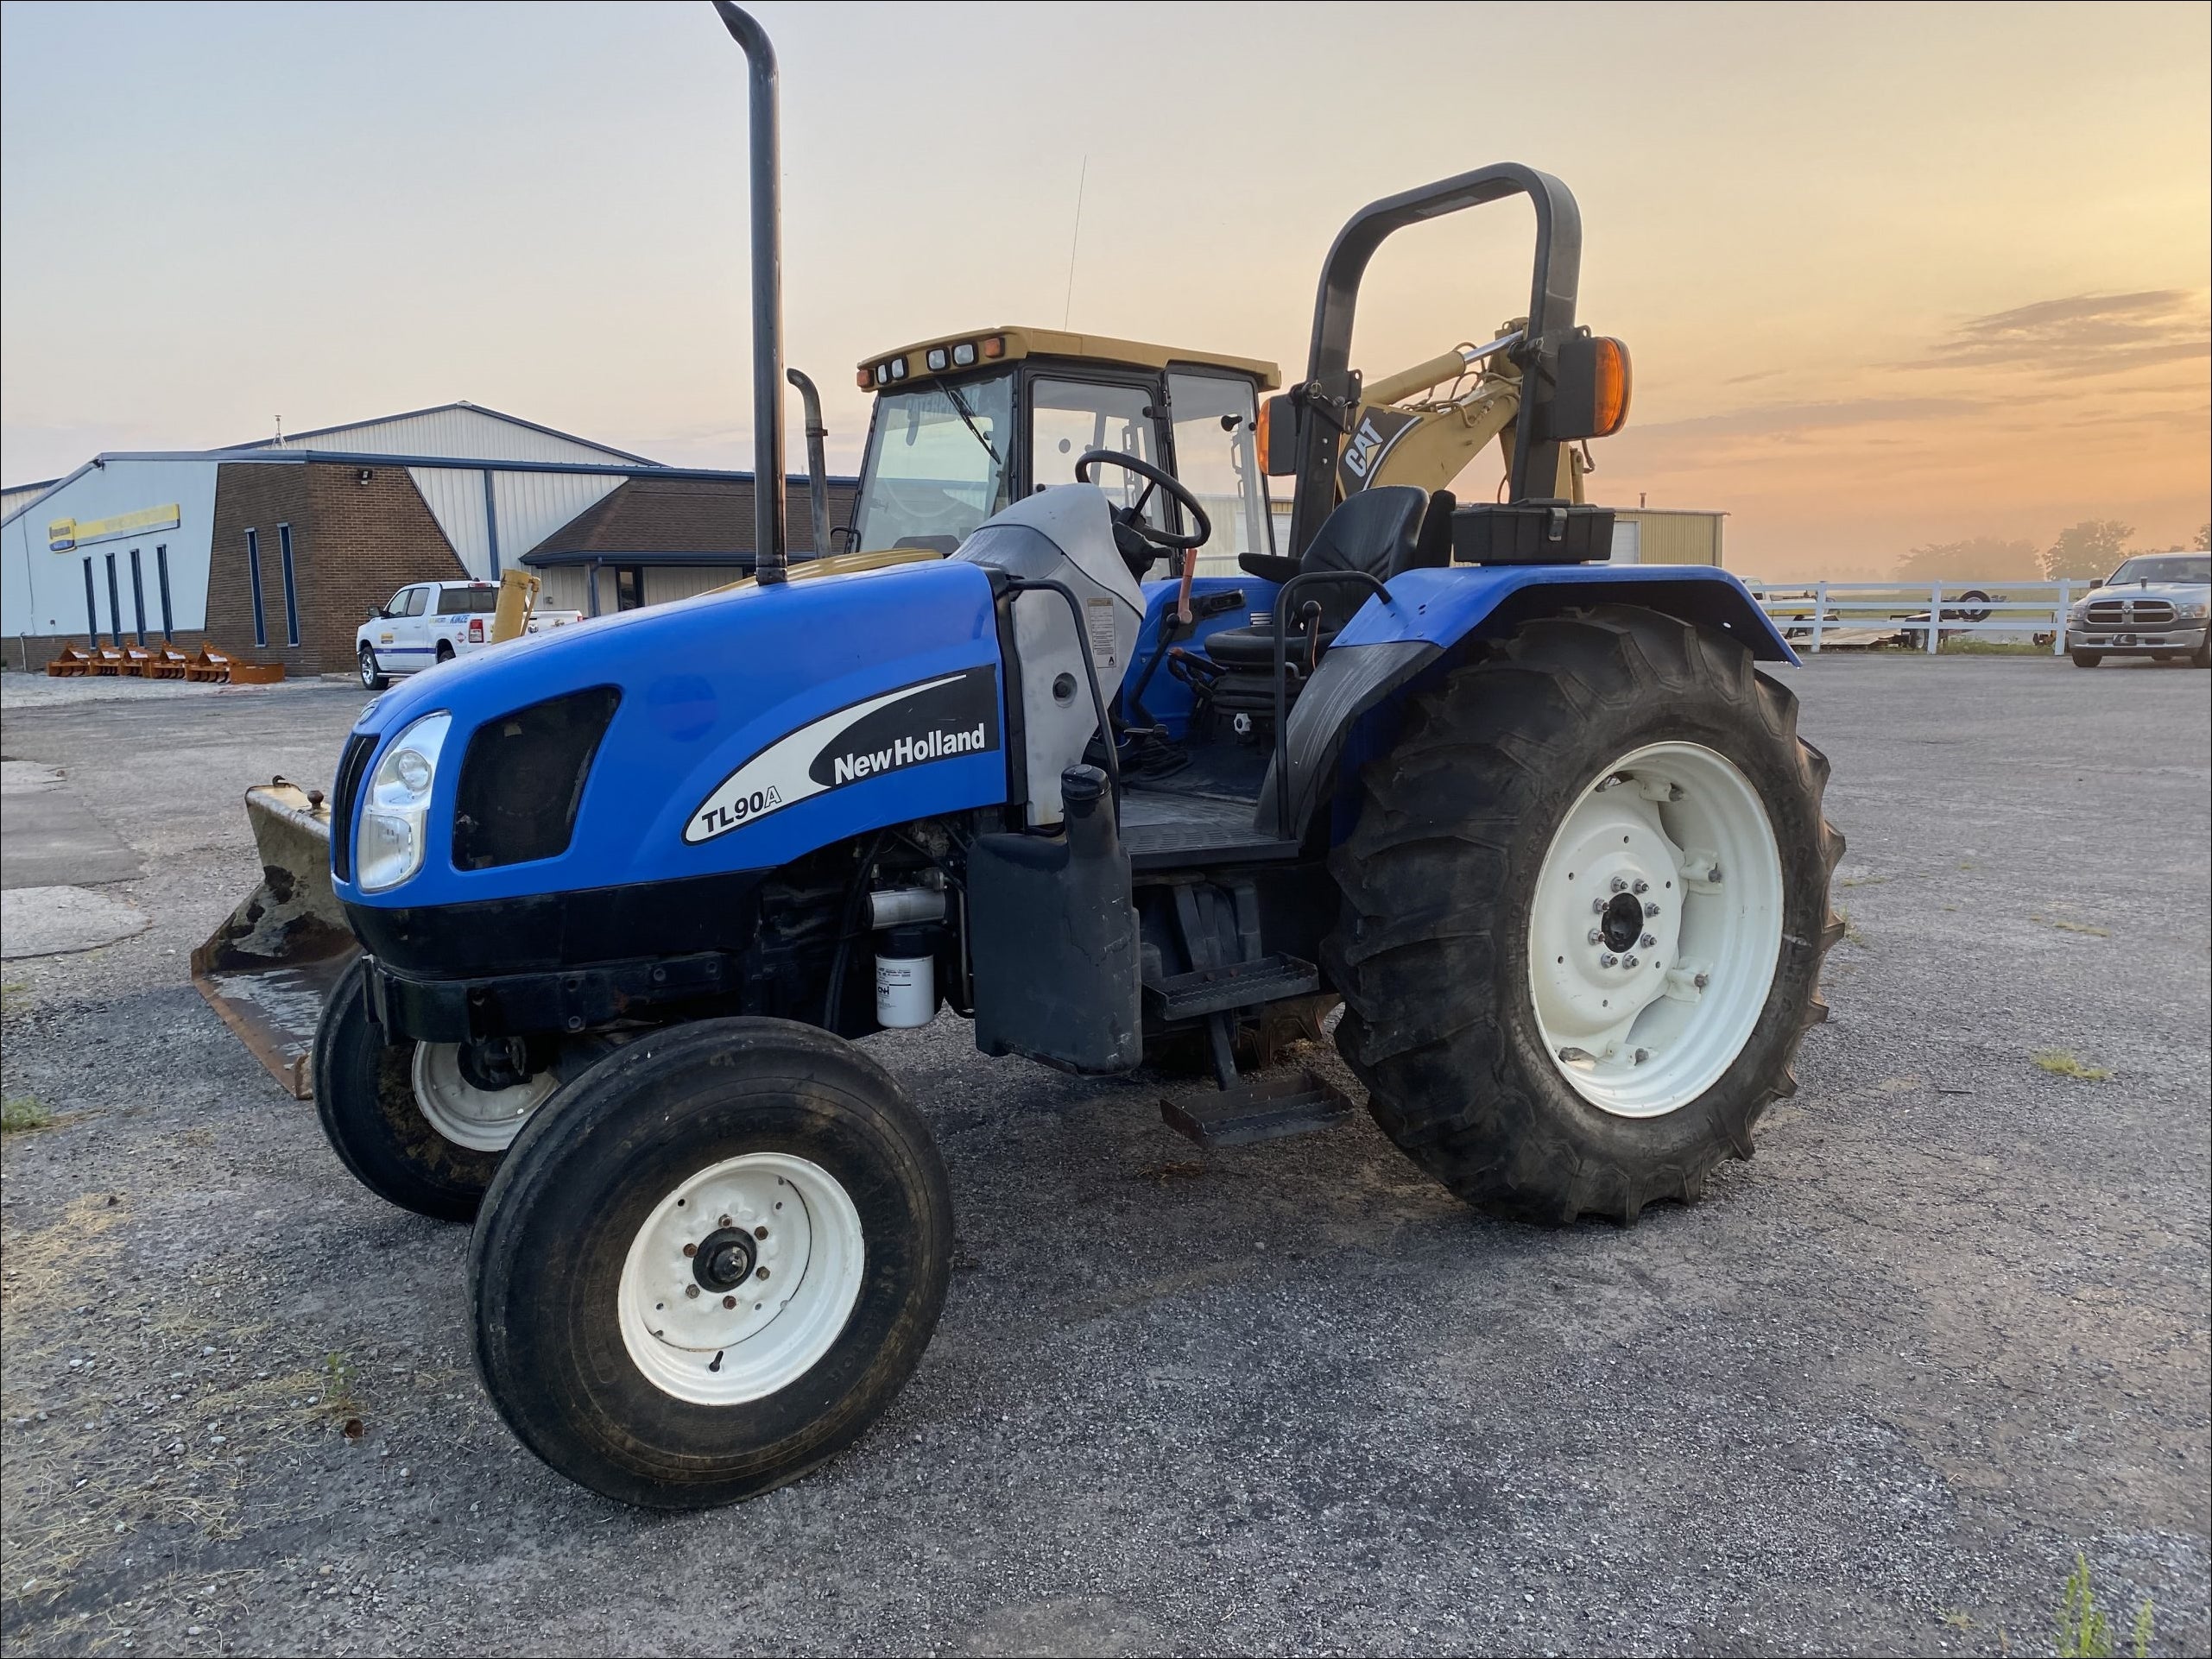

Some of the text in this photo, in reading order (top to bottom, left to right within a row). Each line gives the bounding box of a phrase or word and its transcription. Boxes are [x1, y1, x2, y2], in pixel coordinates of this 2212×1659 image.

[906, 387, 981, 414] CATERPILR
[1345, 417, 1384, 477] CAT
[834, 722, 985, 785] New Holland
[701, 785, 782, 833] TL90A
